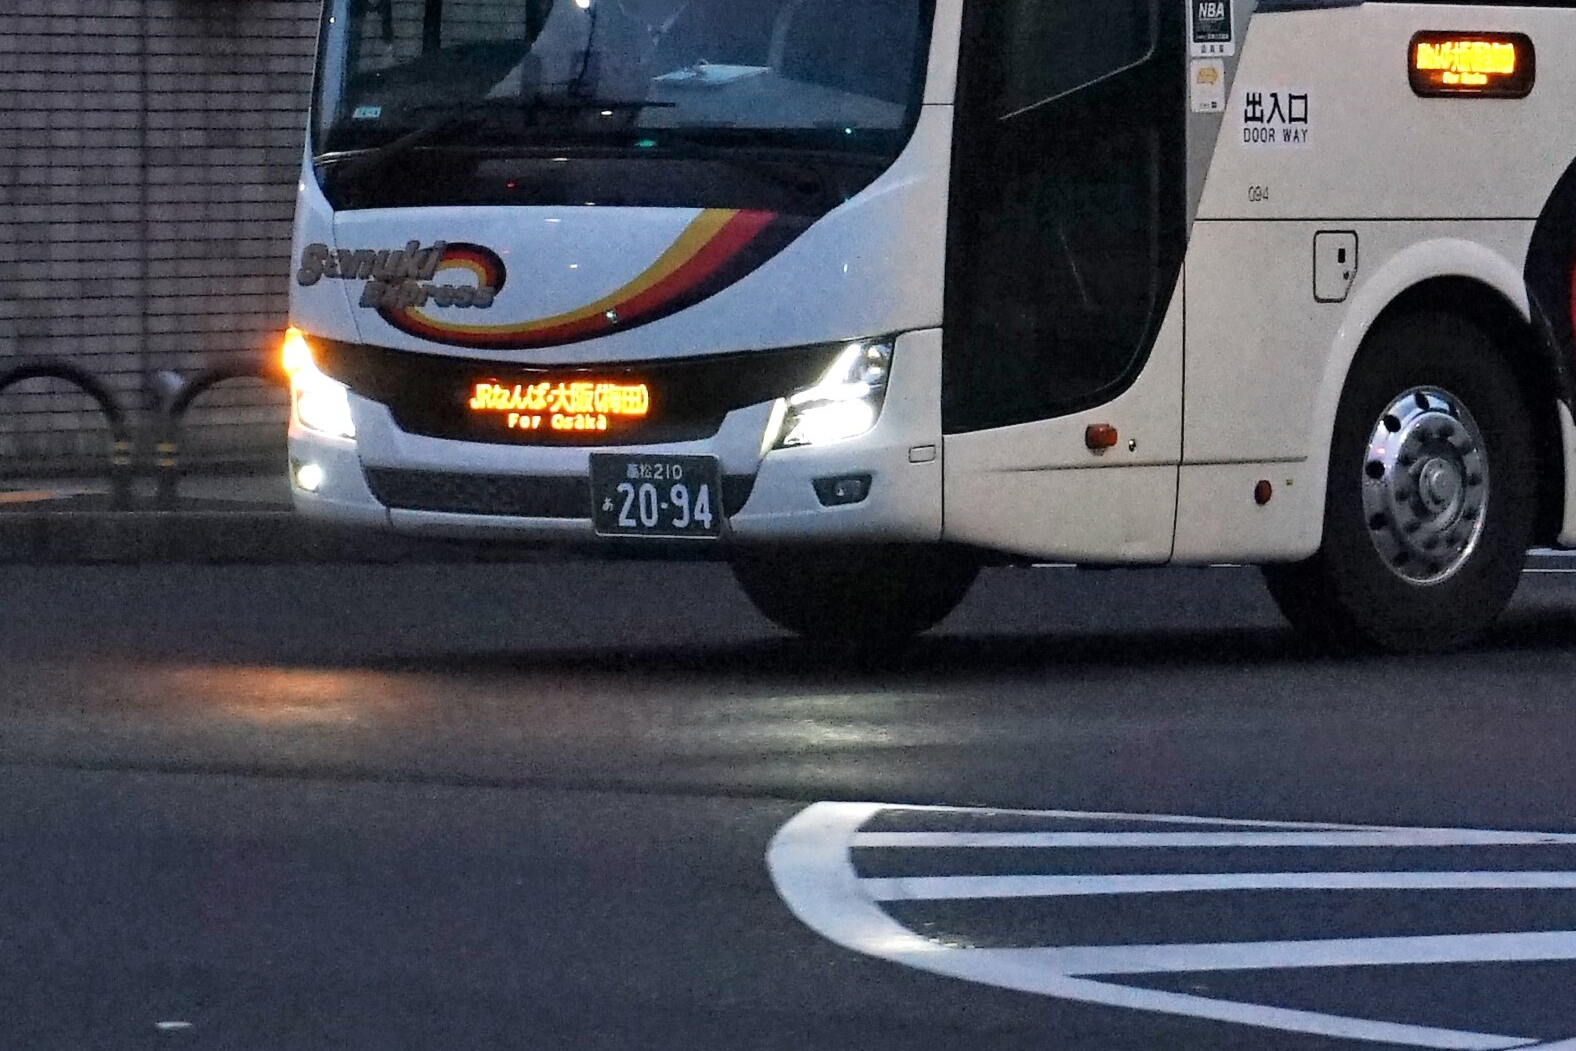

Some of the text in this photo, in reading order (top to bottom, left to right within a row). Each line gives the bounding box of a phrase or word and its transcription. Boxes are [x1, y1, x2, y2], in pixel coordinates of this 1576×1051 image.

[1199, 2, 1225, 18] NBA
[1244, 92, 1308, 125] 出入口
[1243, 127, 1308, 143] DOOR WAY
[1247, 185, 1270, 202] 094
[297, 240, 448, 287] Sanuki
[507, 413, 608, 430] For Osaka
[616, 482, 713, 529] 20-94
